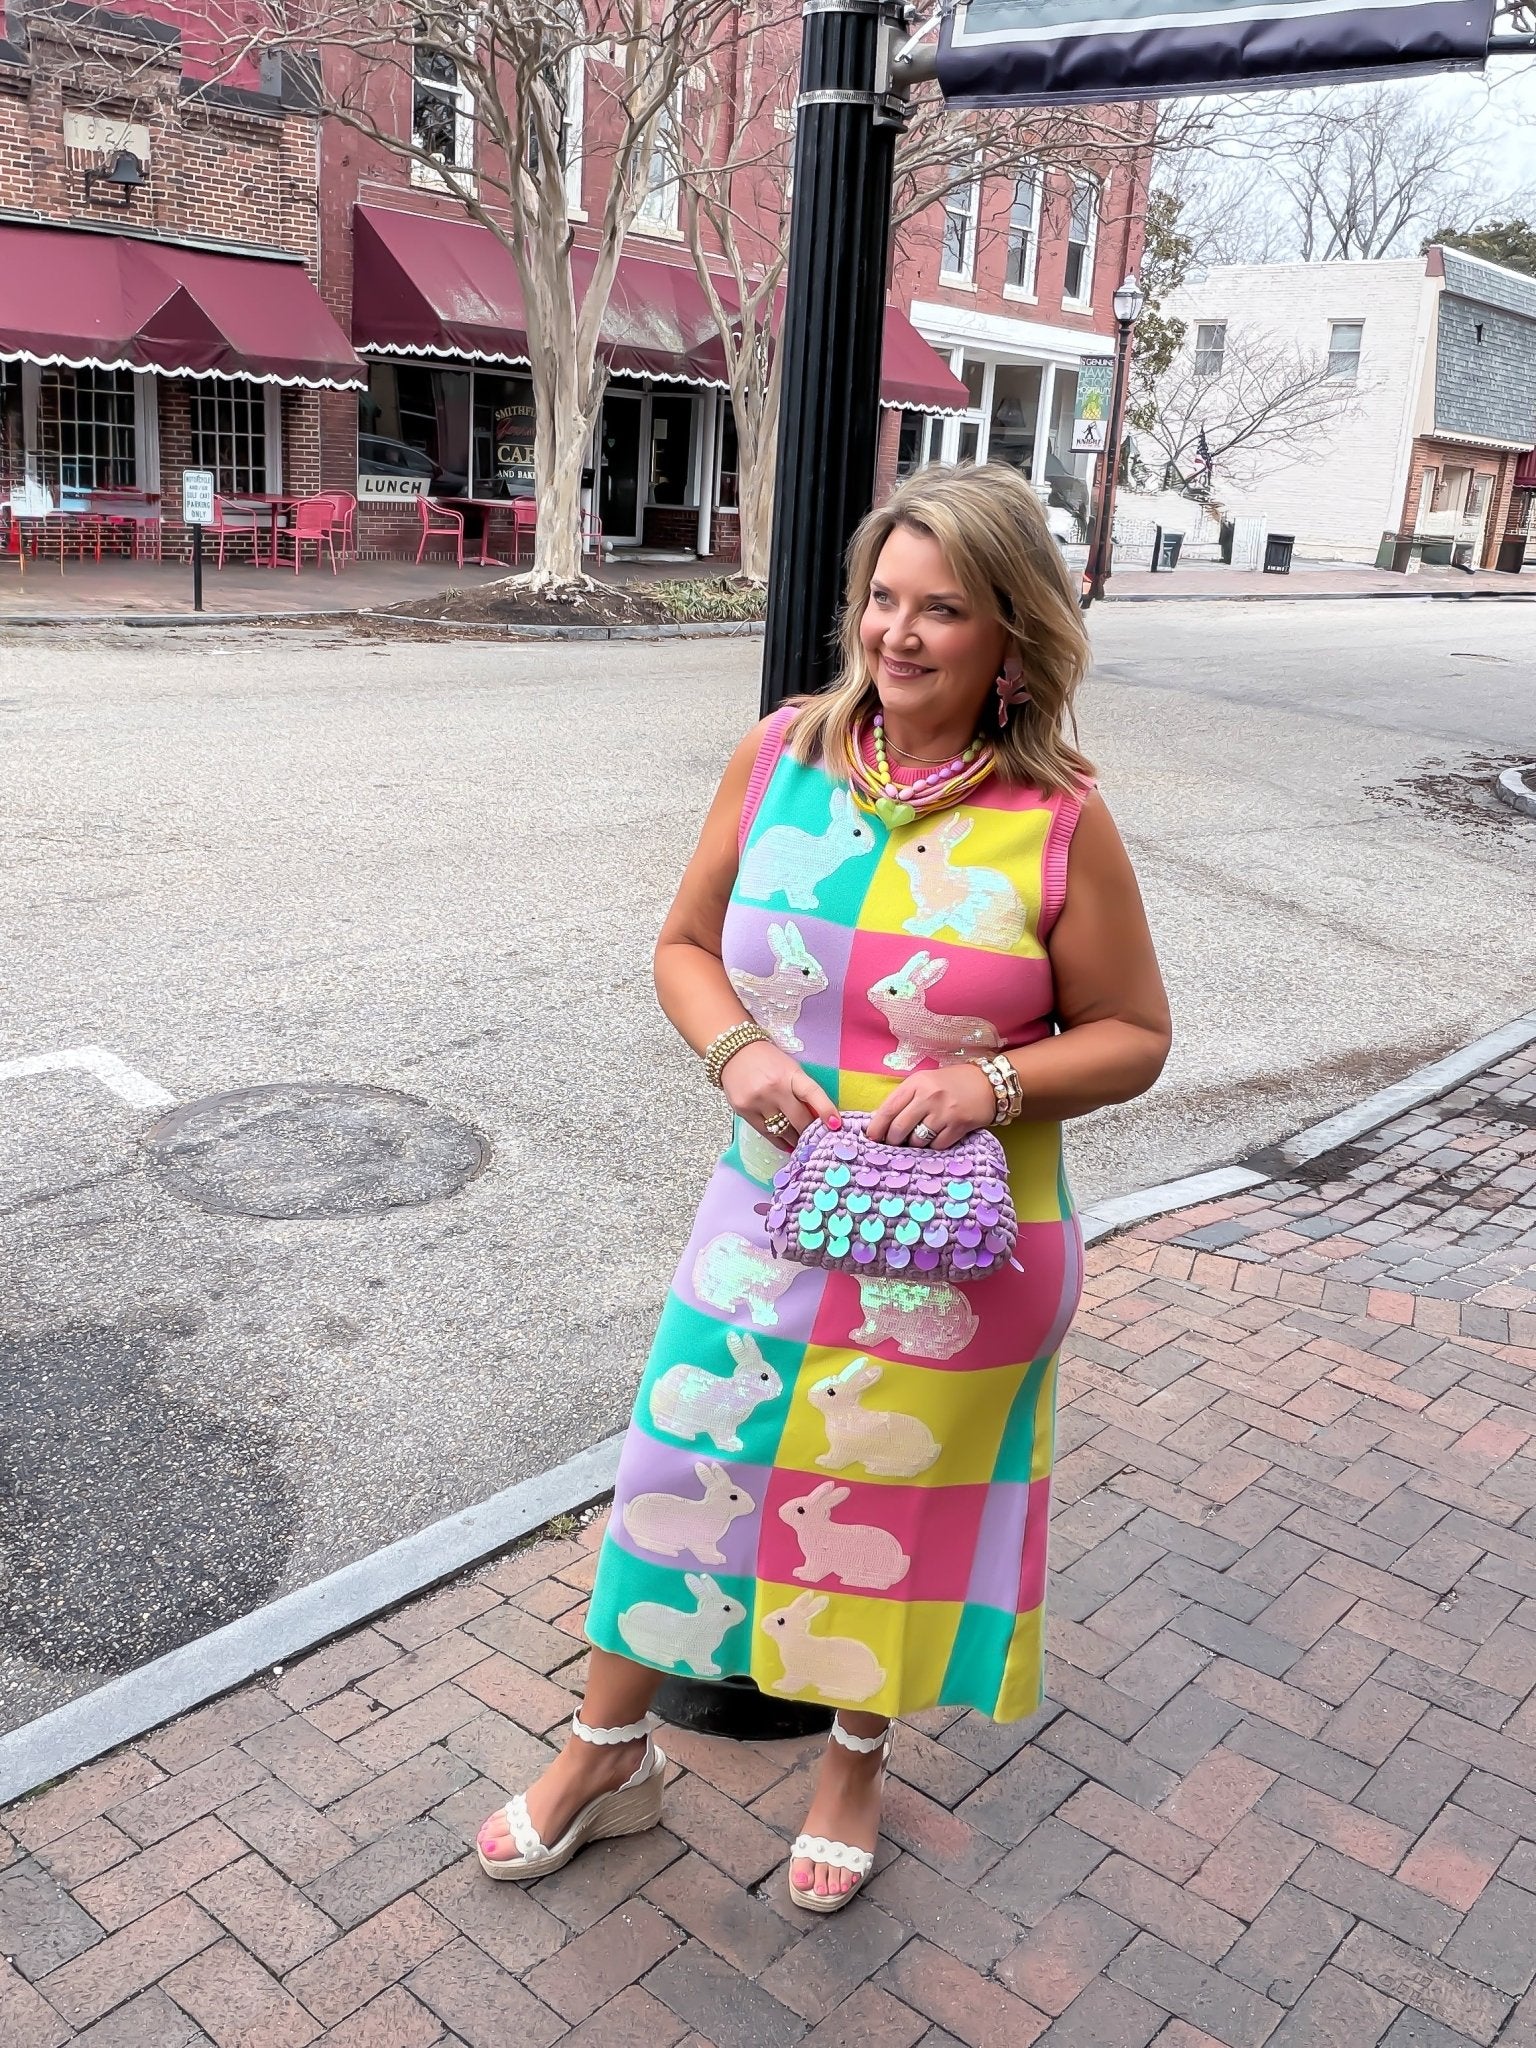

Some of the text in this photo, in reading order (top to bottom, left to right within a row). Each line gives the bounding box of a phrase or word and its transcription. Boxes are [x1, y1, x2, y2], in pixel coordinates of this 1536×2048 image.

[1079, 367, 1113, 379] HAMS
[497, 445, 535, 464] CAF
[496, 470, 536, 480] AND BAK
[365, 479, 422, 494] LUNCH
